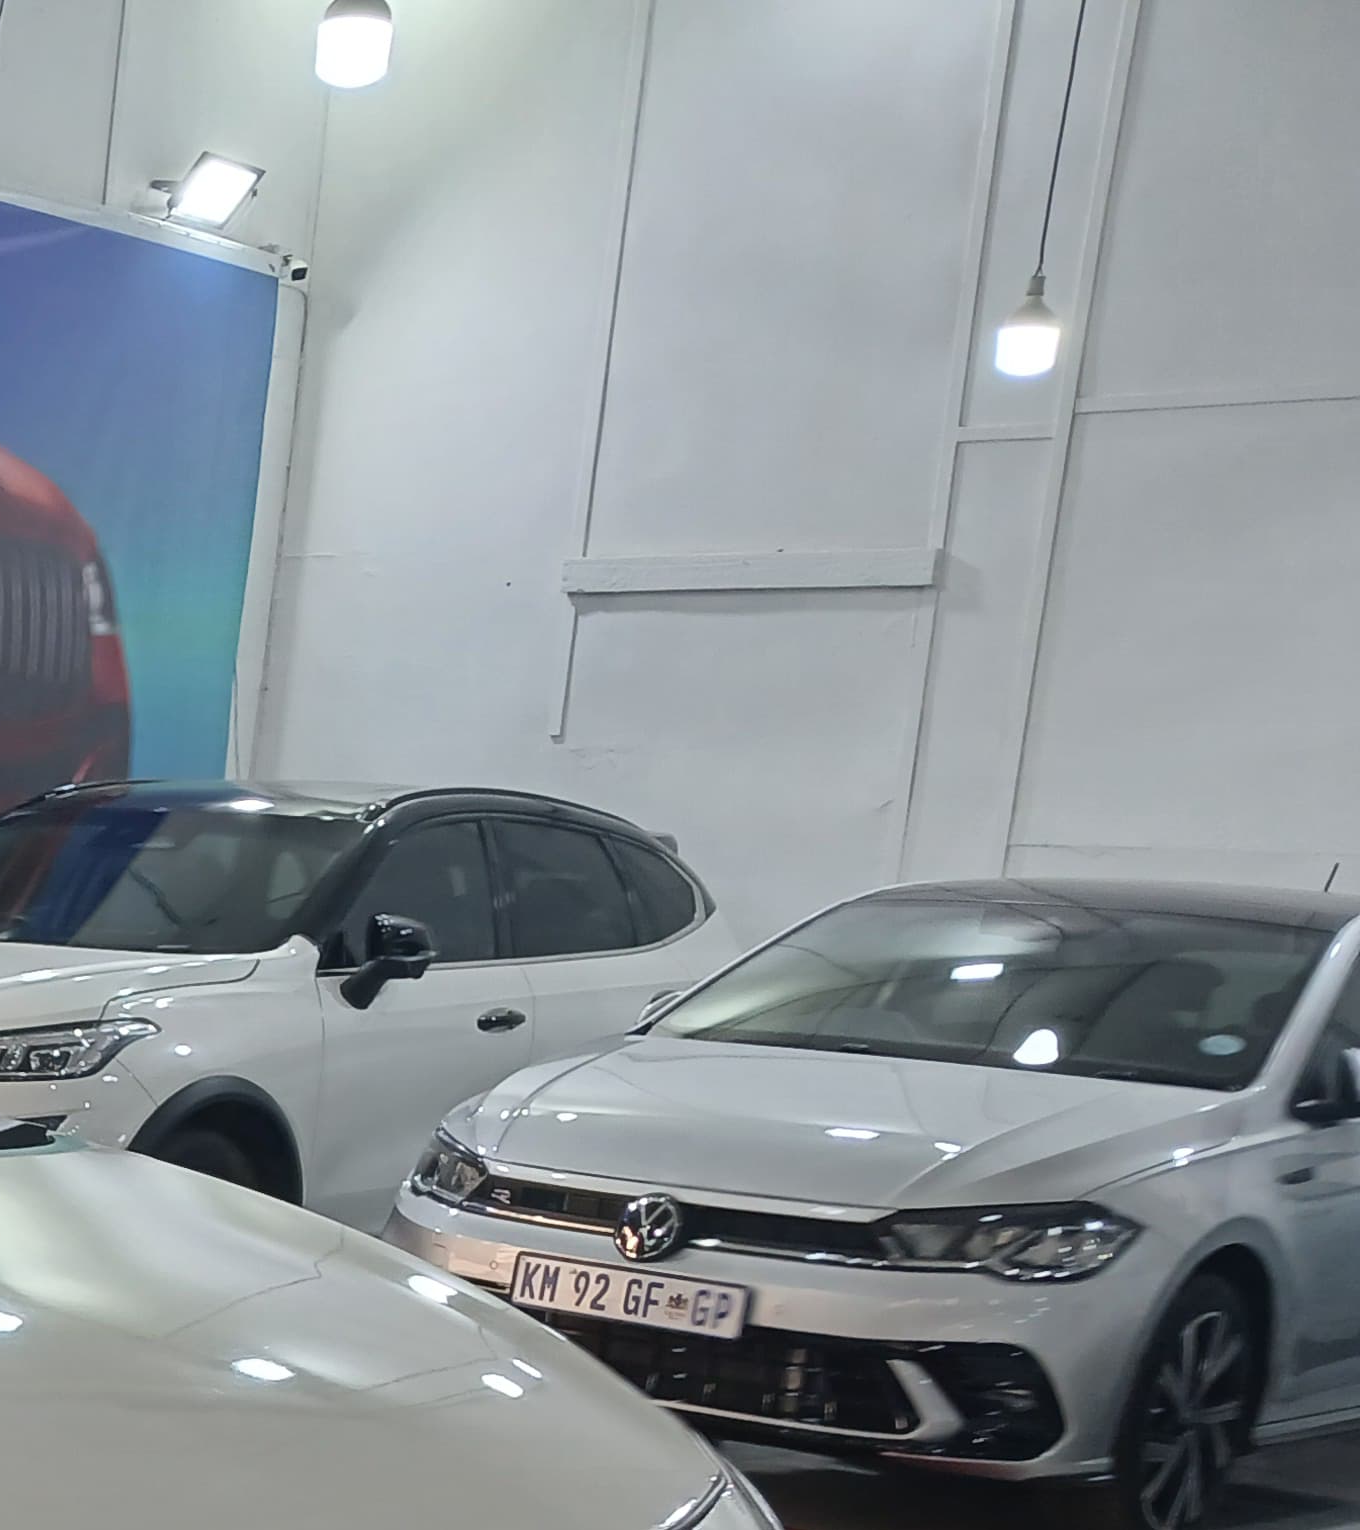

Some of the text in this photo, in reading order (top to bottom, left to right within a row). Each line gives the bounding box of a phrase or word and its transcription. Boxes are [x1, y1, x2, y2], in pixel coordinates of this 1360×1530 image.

[519, 1261, 732, 1329] KM 92 GF GP
